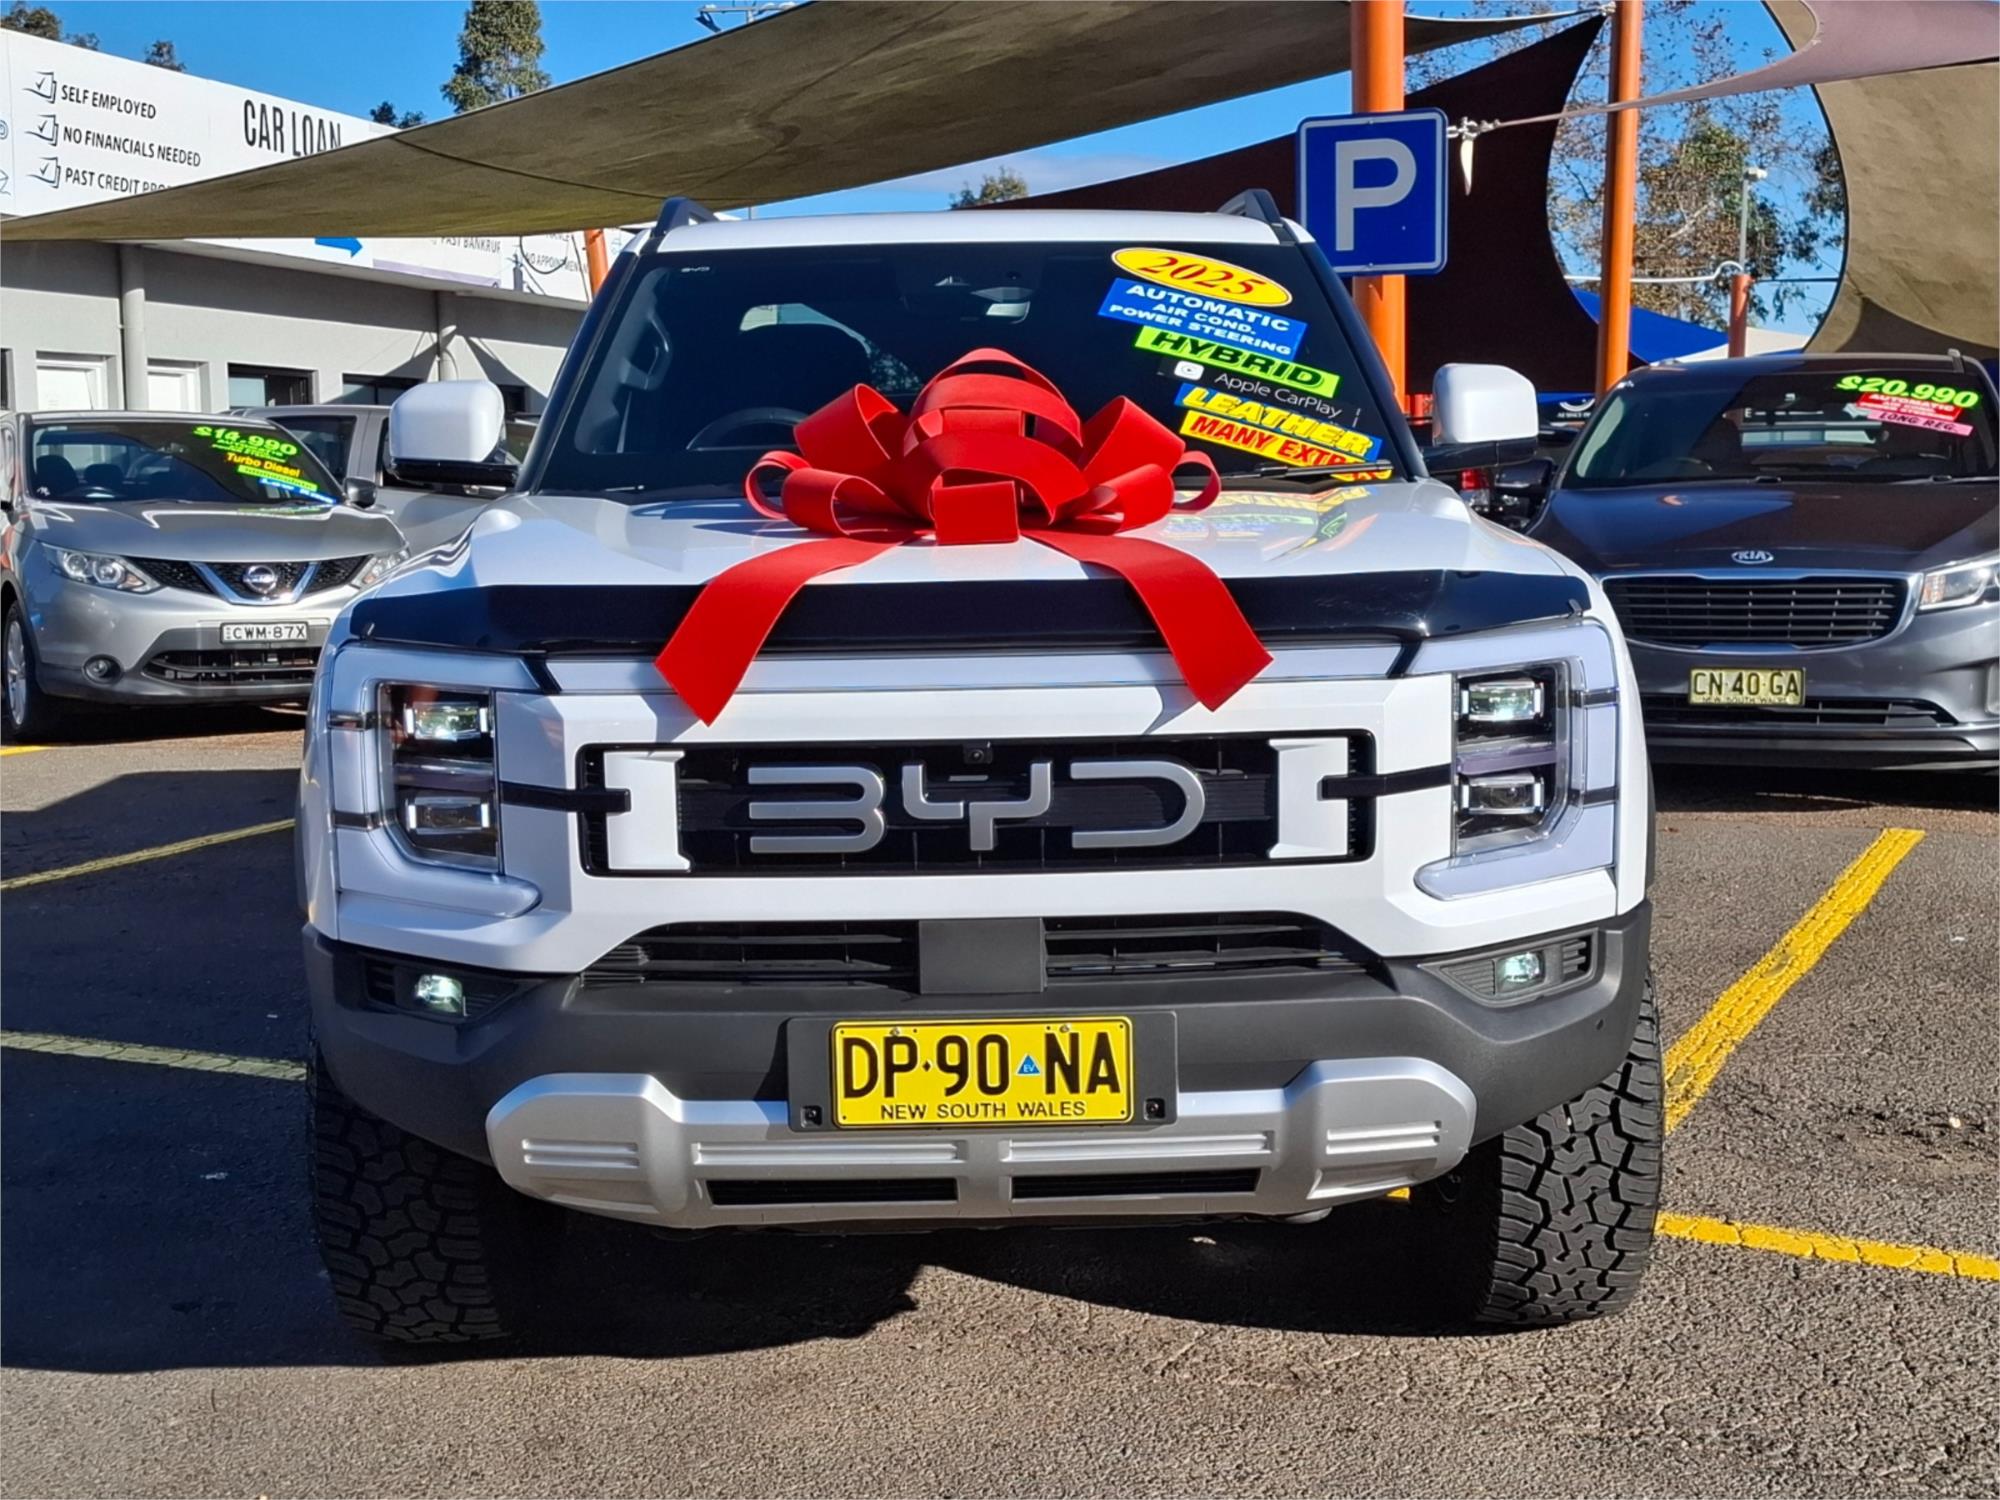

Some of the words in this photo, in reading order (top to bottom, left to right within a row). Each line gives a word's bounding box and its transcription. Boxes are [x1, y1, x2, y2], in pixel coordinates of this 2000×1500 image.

[61, 84, 90, 104] SELF
[92, 92, 157, 119] EMPLOYED
[63, 126, 83, 144] NO
[85, 131, 155, 158] FINANCIALS
[157, 145, 201, 168] NEEDED
[244, 99, 284, 153] CAR
[292, 111, 341, 157] LOAN
[66, 167, 96, 187] PAST
[98, 173, 140, 195] CREDIT
[1335, 137, 1417, 252] P
[1138, 256, 1268, 295] 2025
[1126, 284, 1291, 333] AUTOMATIC
[1152, 303, 1189, 318] AIR
[1193, 312, 1257, 335] COND.
[1109, 304, 1184, 328] POWER
[1188, 321, 1292, 356] STEERING
[1151, 332, 1324, 387] HYBRID
[1214, 372, 1273, 396] Apple
[1274, 387, 1343, 418] CarPlay
[1182, 387, 1374, 454] LEATHER
[1190, 416, 1272, 448] MANY
[1880, 412, 1918, 424] LONG
[226, 453, 262, 468] Turbo
[263, 460, 301, 478] Diesel
[1738, 551, 1766, 560] KIA
[748, 760, 1205, 853] BYD
[881, 1104, 927, 1120] NEW
[936, 1103, 1006, 1119] SOUTH
[1019, 1101, 1086, 1118] WALES
